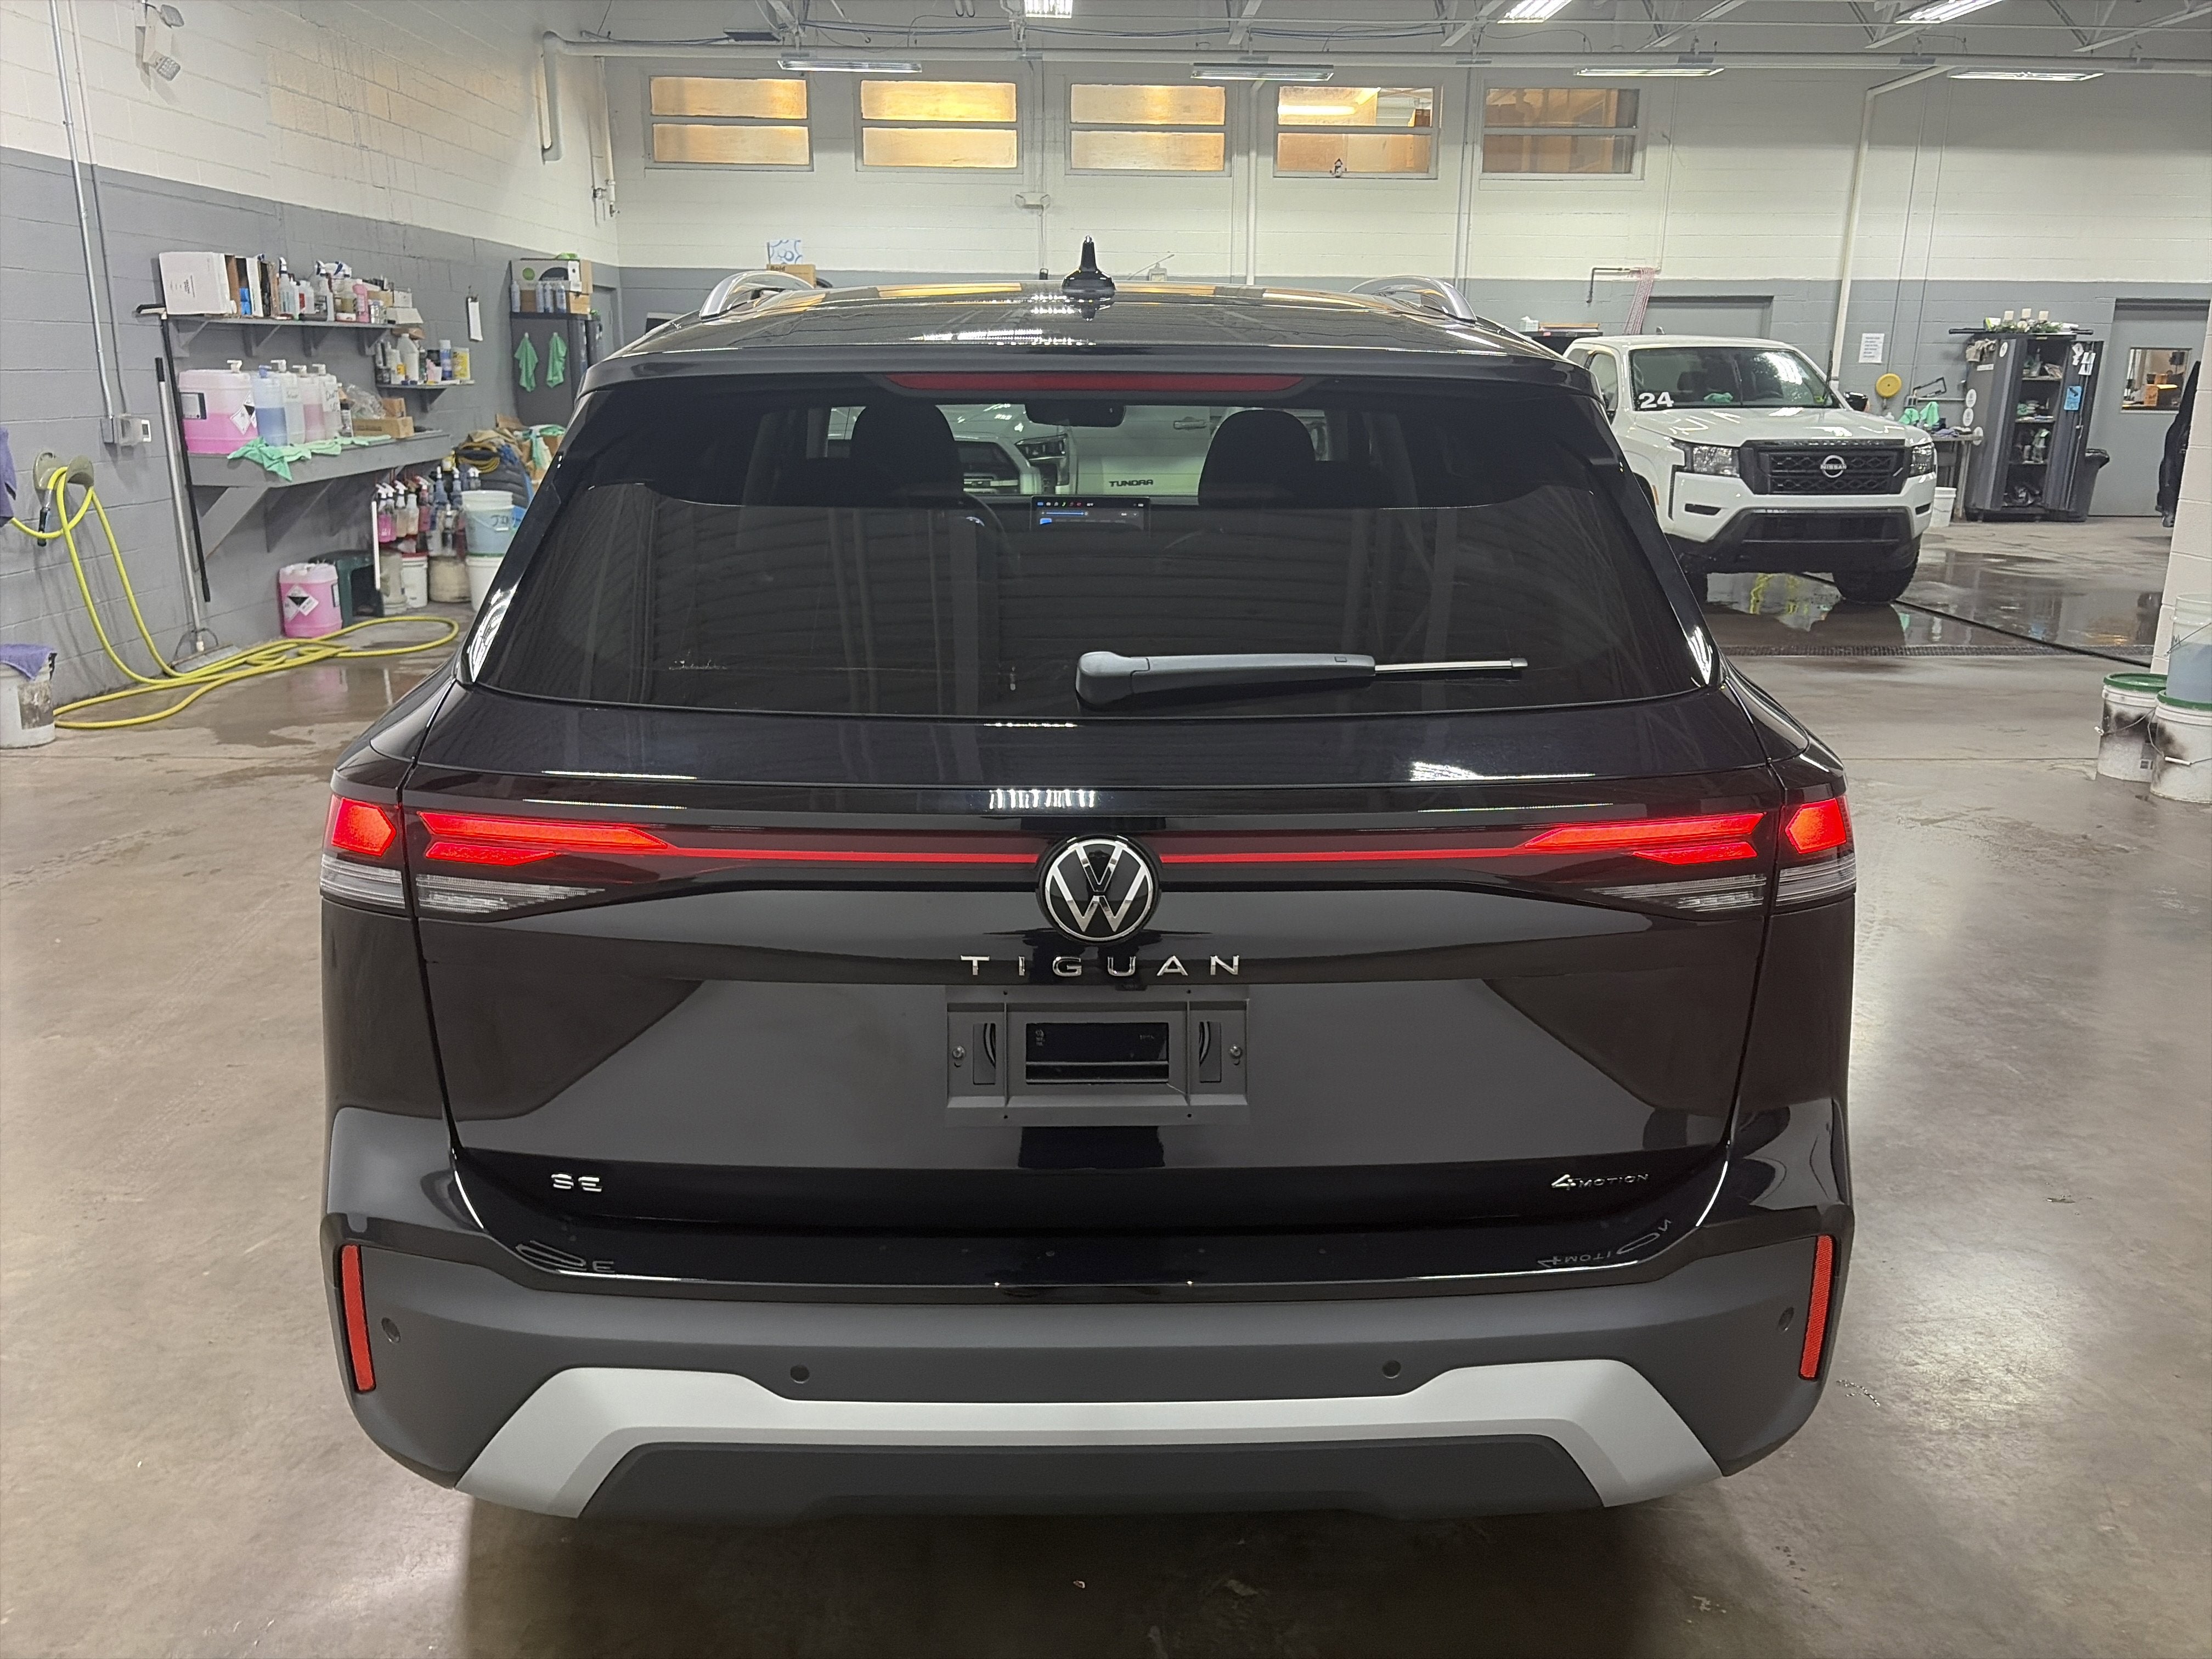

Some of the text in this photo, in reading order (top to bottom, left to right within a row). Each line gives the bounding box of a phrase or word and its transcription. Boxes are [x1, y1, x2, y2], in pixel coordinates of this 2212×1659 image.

[1638, 391, 1675, 409] 24
[1108, 479, 1154, 487] TUNDRA
[960, 955, 1240, 977] TIGUAN
[551, 1172, 603, 1192] SE
[1551, 1173, 1649, 1191] 4MOTION
